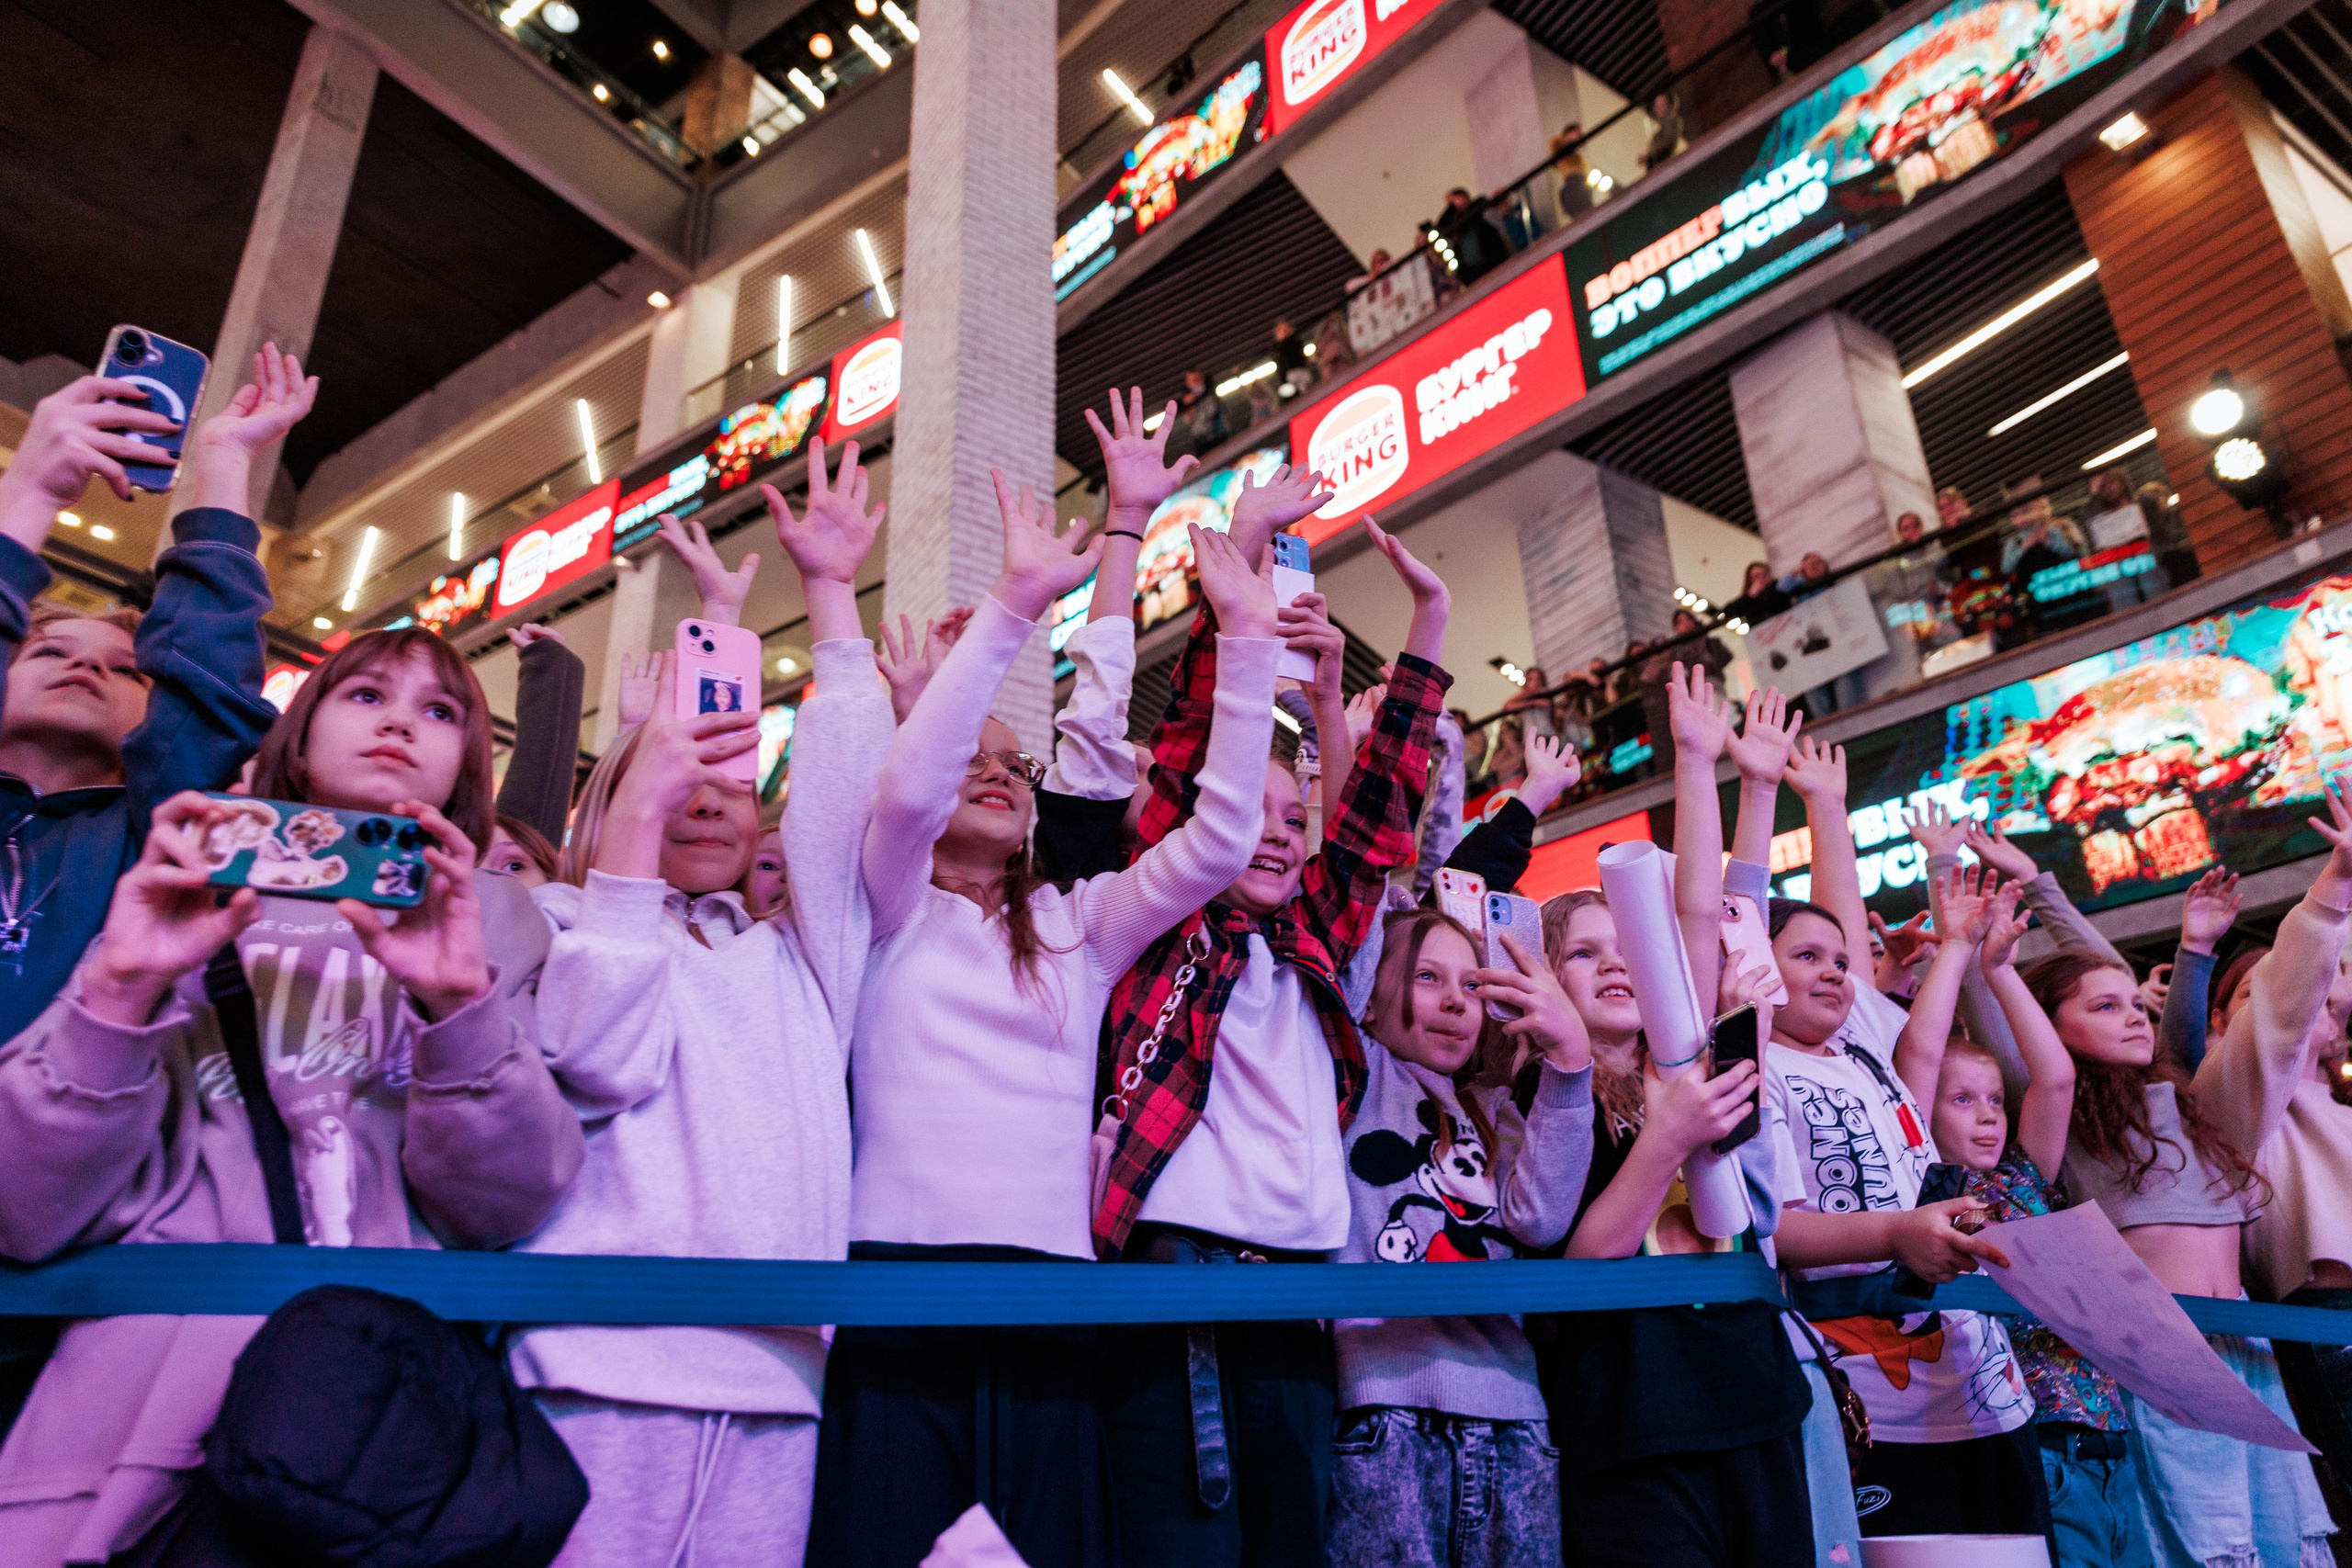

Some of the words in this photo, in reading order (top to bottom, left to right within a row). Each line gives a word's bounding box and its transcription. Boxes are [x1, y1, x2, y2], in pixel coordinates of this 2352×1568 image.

[1292, 21, 1358, 85] KING
[1589, 276, 1667, 339] ЭТО
[1667, 180, 1828, 296] ВКУСНО
[1416, 308, 1553, 413] БУРГЕР
[1419, 362, 1517, 445] КИНГ
[1317, 413, 1395, 468] BURGER
[1320, 434, 1397, 492] KING
